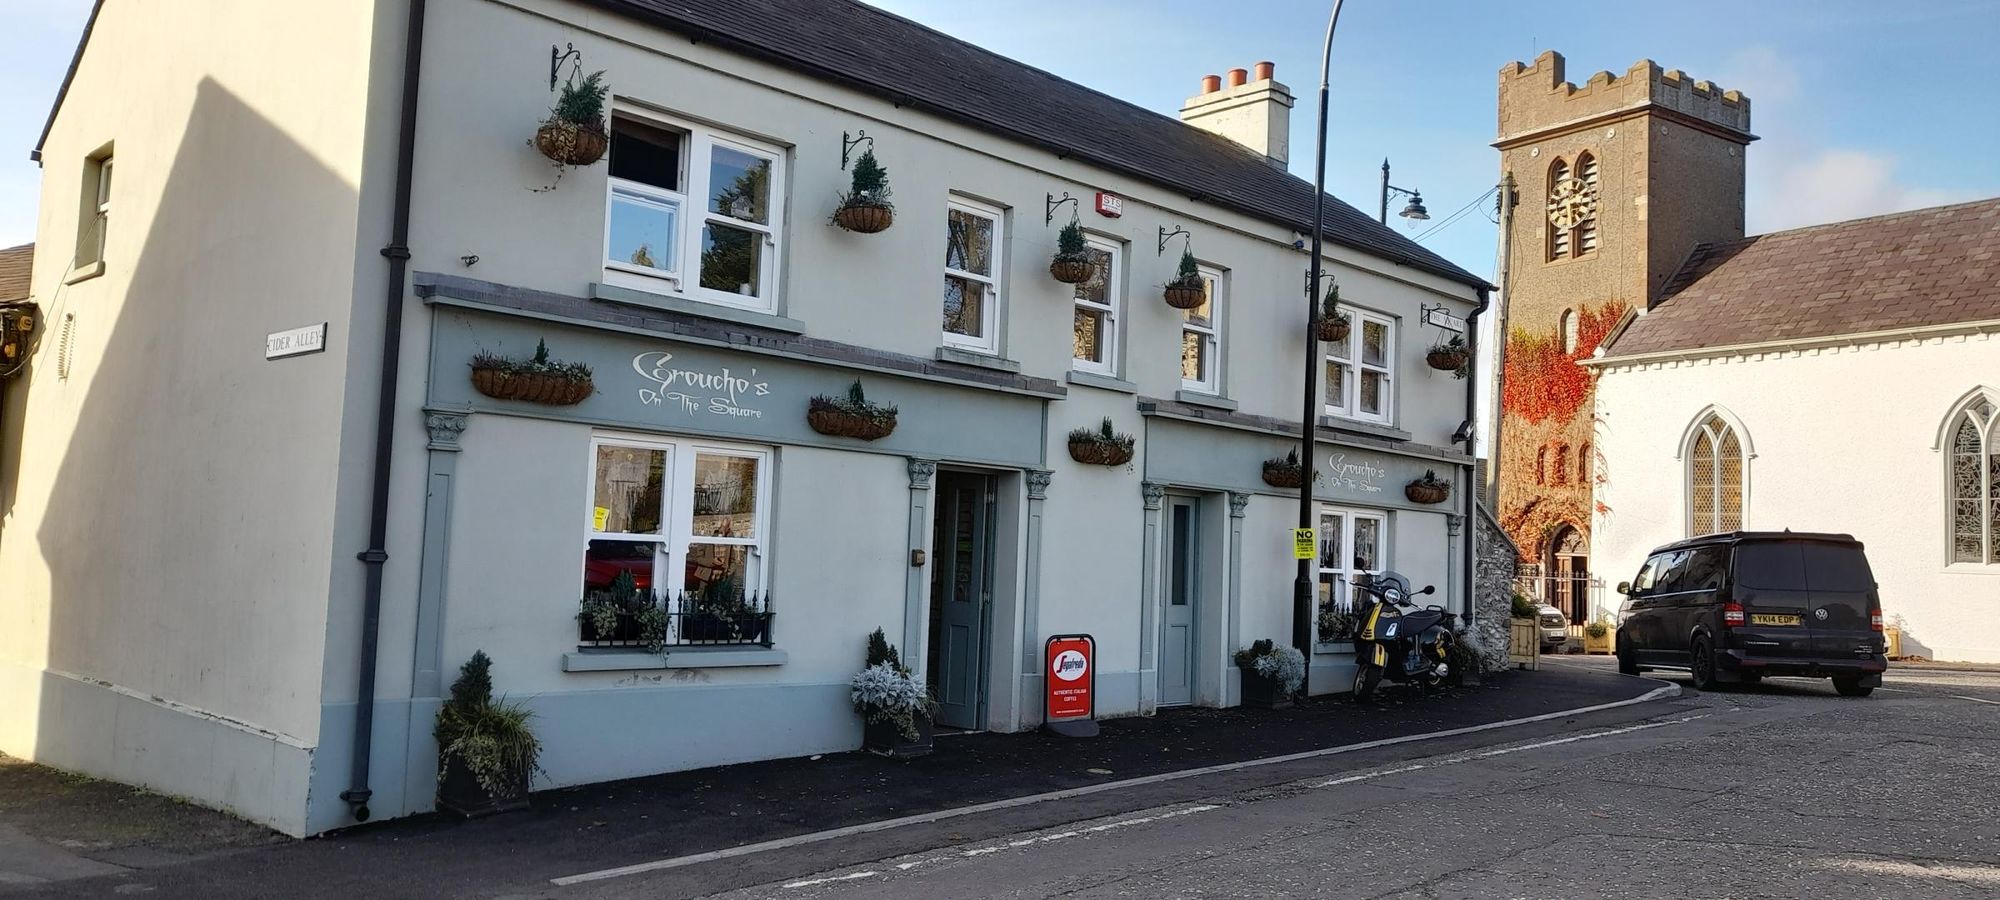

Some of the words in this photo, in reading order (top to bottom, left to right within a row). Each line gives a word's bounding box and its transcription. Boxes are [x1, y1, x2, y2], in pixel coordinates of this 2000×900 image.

[1103, 195, 1121, 208] STS
[1431, 313, 1441, 321] THE
[268, 336, 291, 351] CIDER
[294, 330, 321, 347] ALLEY
[632, 351, 771, 407] Groucho's
[638, 388, 662, 407] On
[666, 391, 701, 417] The
[708, 397, 762, 419] Square
[1329, 452, 1385, 485] Groucho's
[1296, 530, 1313, 539] NO
[1757, 615, 1776, 623] YK14
